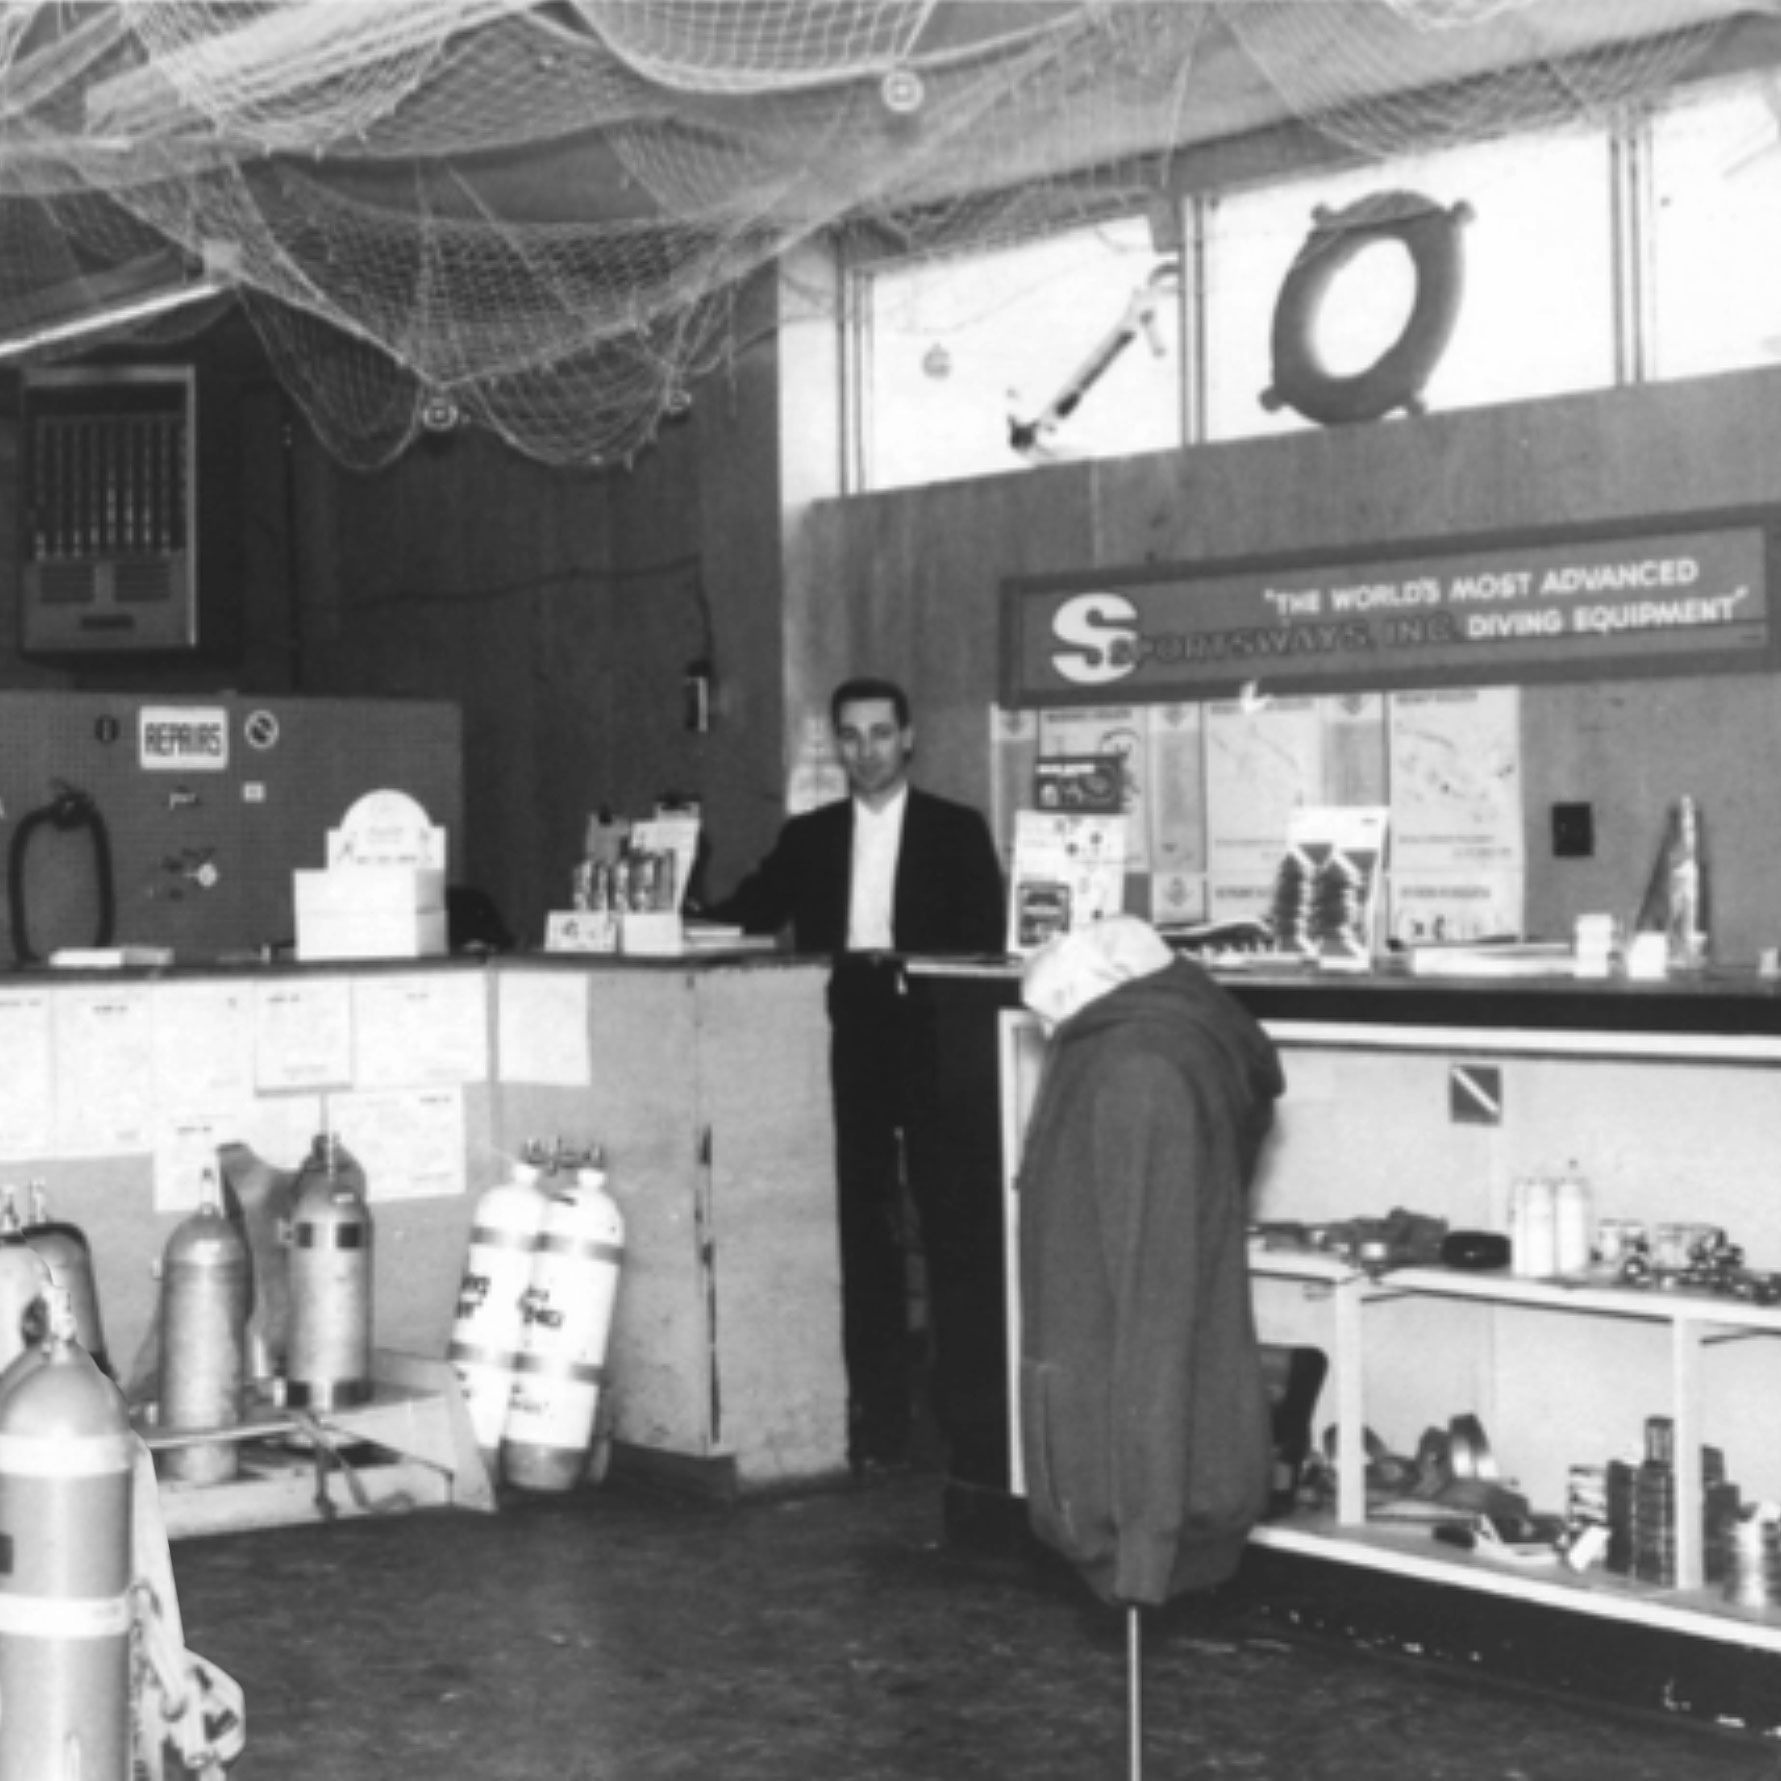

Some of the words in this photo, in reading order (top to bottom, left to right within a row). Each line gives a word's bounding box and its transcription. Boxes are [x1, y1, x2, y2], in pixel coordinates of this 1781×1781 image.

[1449, 572, 1532, 601] MOST
[1540, 557, 1700, 595] ADVANCED
[1468, 608, 1563, 639] DIVING
[145, 721, 222, 757] REPAIRS
